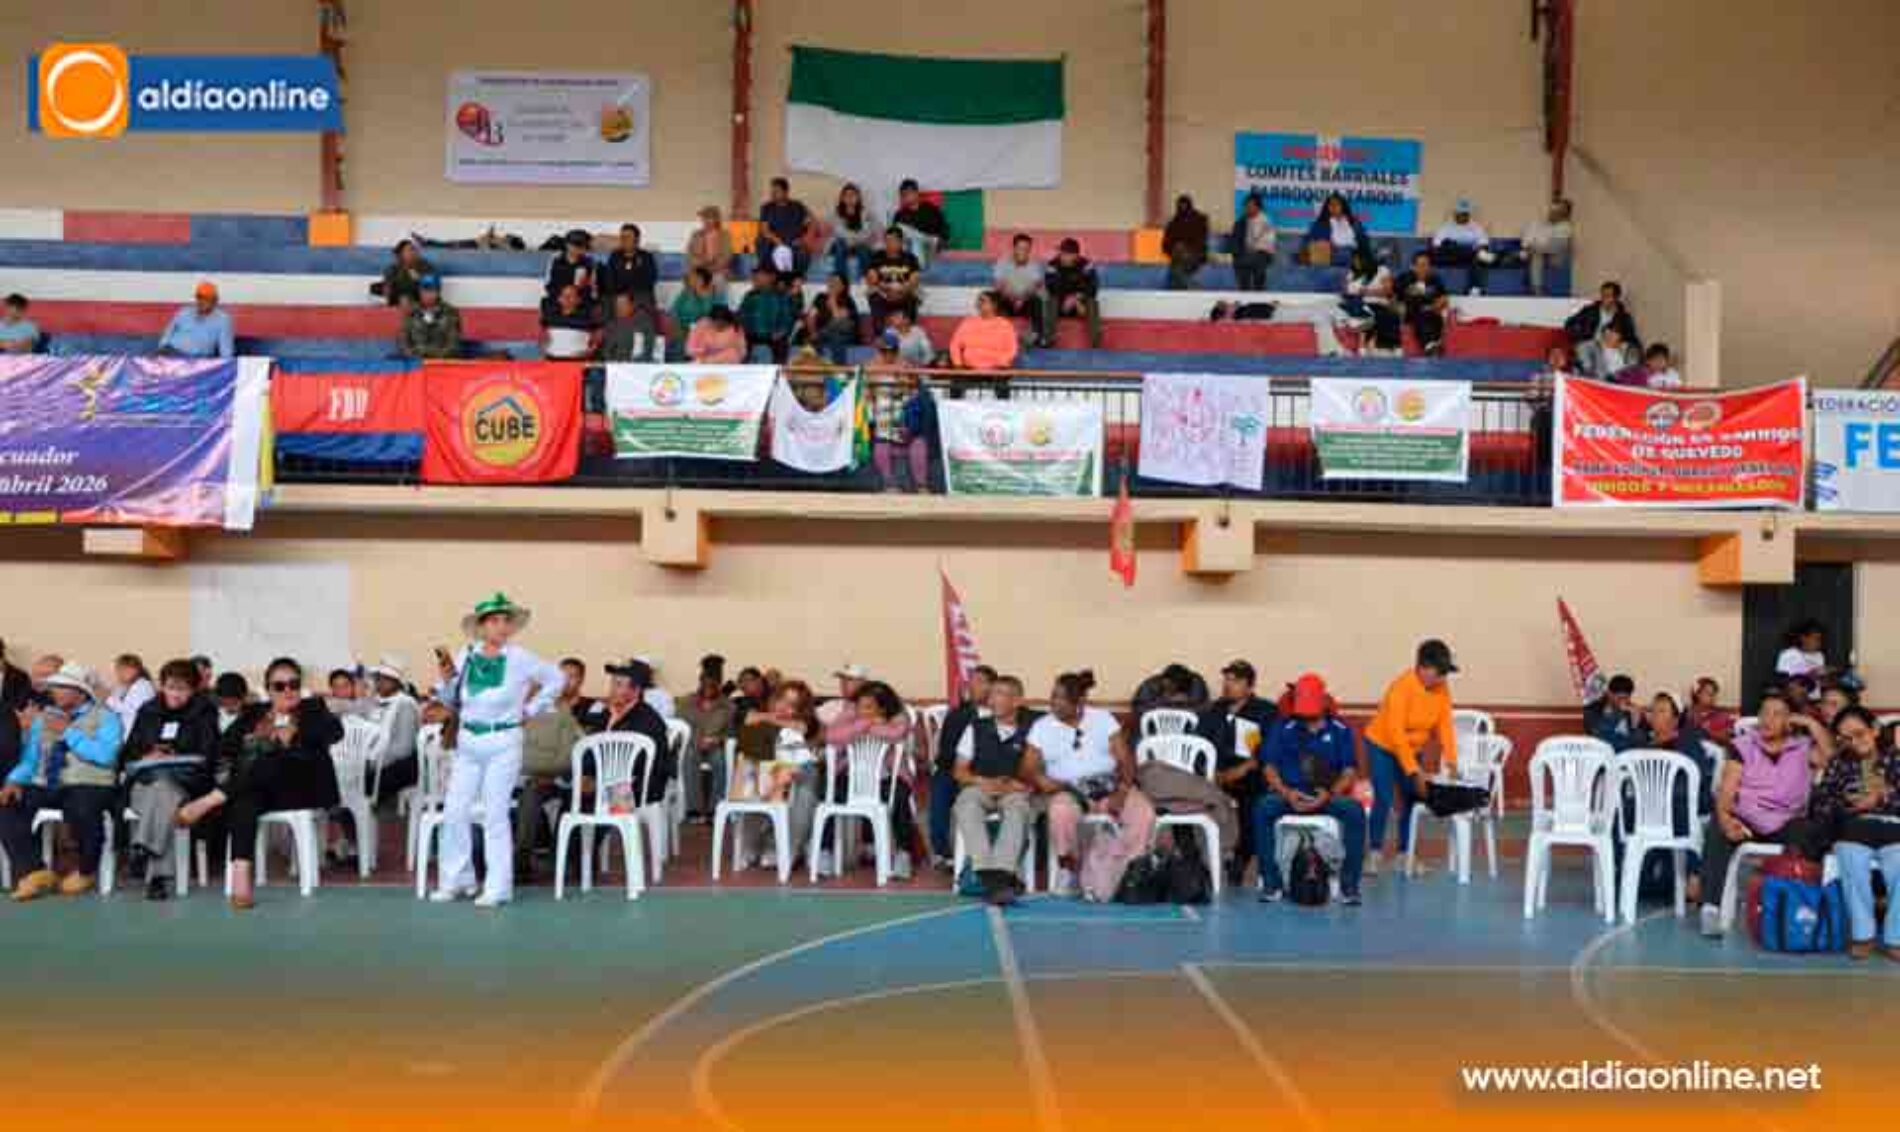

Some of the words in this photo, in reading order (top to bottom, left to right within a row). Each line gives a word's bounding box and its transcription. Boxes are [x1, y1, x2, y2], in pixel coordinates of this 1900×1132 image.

[474, 413, 536, 441] CUBE
[0, 445, 80, 465] cuador
[1844, 422, 1900, 468] FE
[56, 474, 110, 493] 2026
